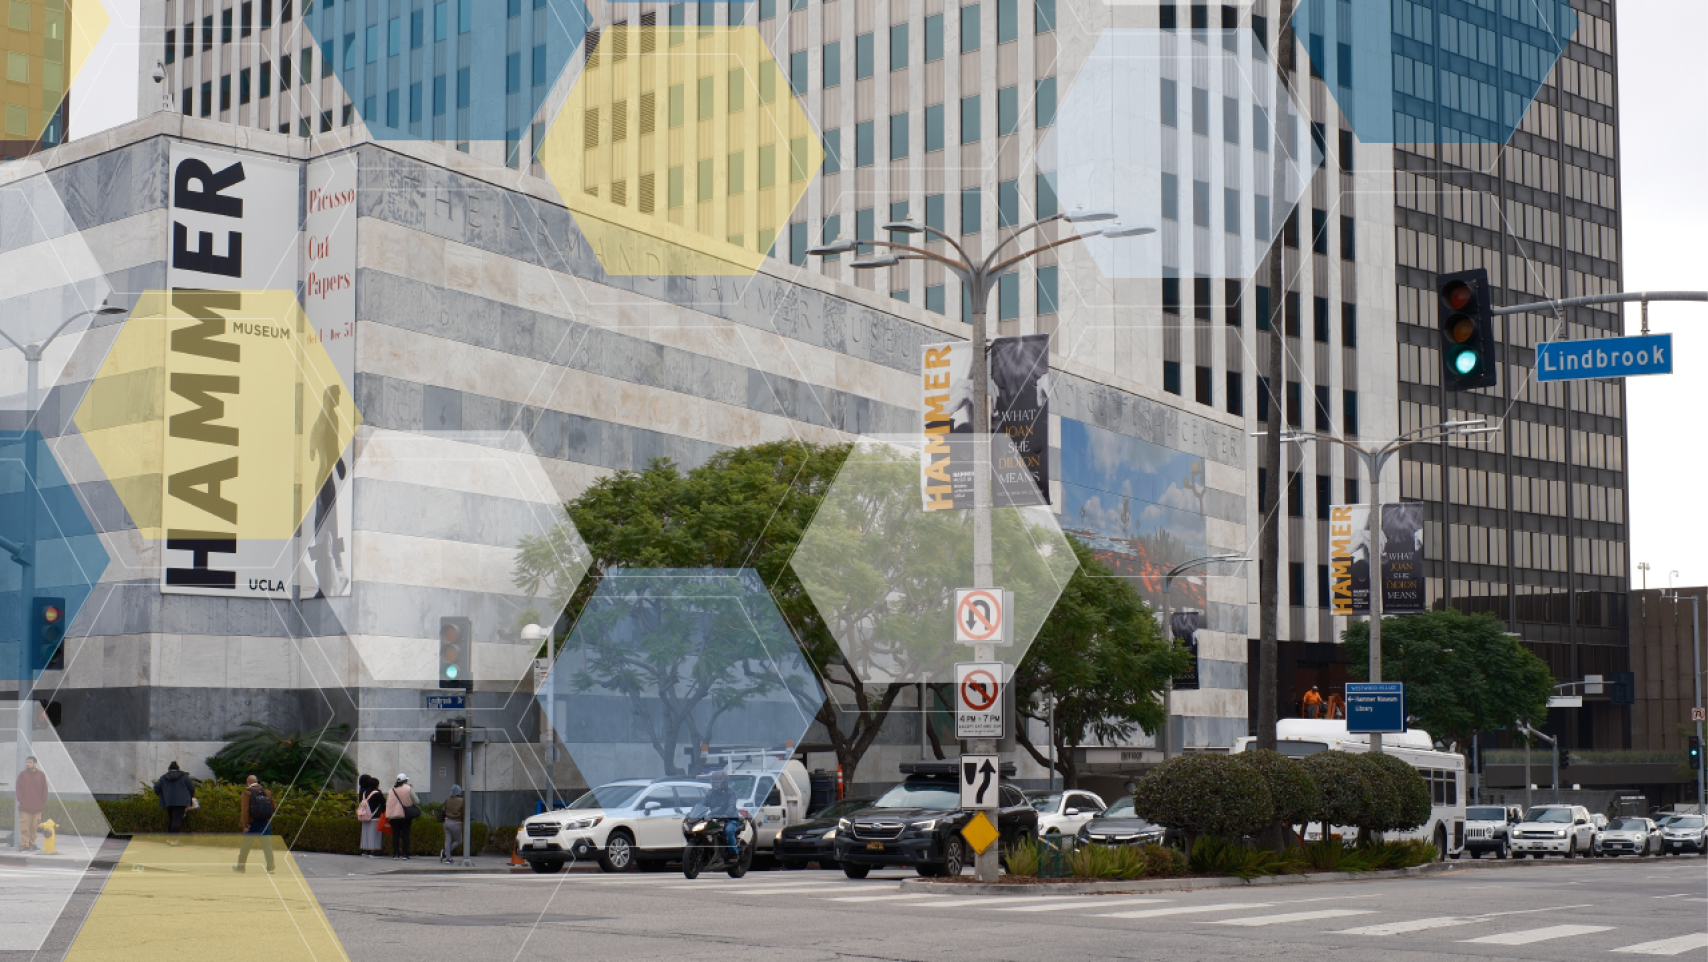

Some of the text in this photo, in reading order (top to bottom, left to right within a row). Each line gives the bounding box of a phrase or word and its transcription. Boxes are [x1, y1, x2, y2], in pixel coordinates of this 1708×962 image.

[309, 188, 355, 214] Picasso
[308, 235, 330, 261] Cut
[509, 212, 661, 282] ARMAND
[685, 263, 812, 329] HAMMER
[308, 272, 351, 300] Papers
[233, 322, 290, 339] MUSEUM
[1544, 344, 1665, 371] Lindbrook
[166, 157, 246, 589] HAMMER
[1001, 408, 1036, 422] WHAT
[924, 345, 954, 510] HAMMER
[1004, 424, 1034, 438] JOAN
[1008, 441, 1030, 454] SHE
[998, 455, 1040, 469] DIDION
[999, 471, 1040, 483] MEANS
[1331, 506, 1352, 615] HAMMER
[1388, 552, 1414, 560] WHAT
[1391, 562, 1413, 571] JOAN
[249, 578, 286, 592] UCLA
[1387, 591, 1417, 599] MEANS
